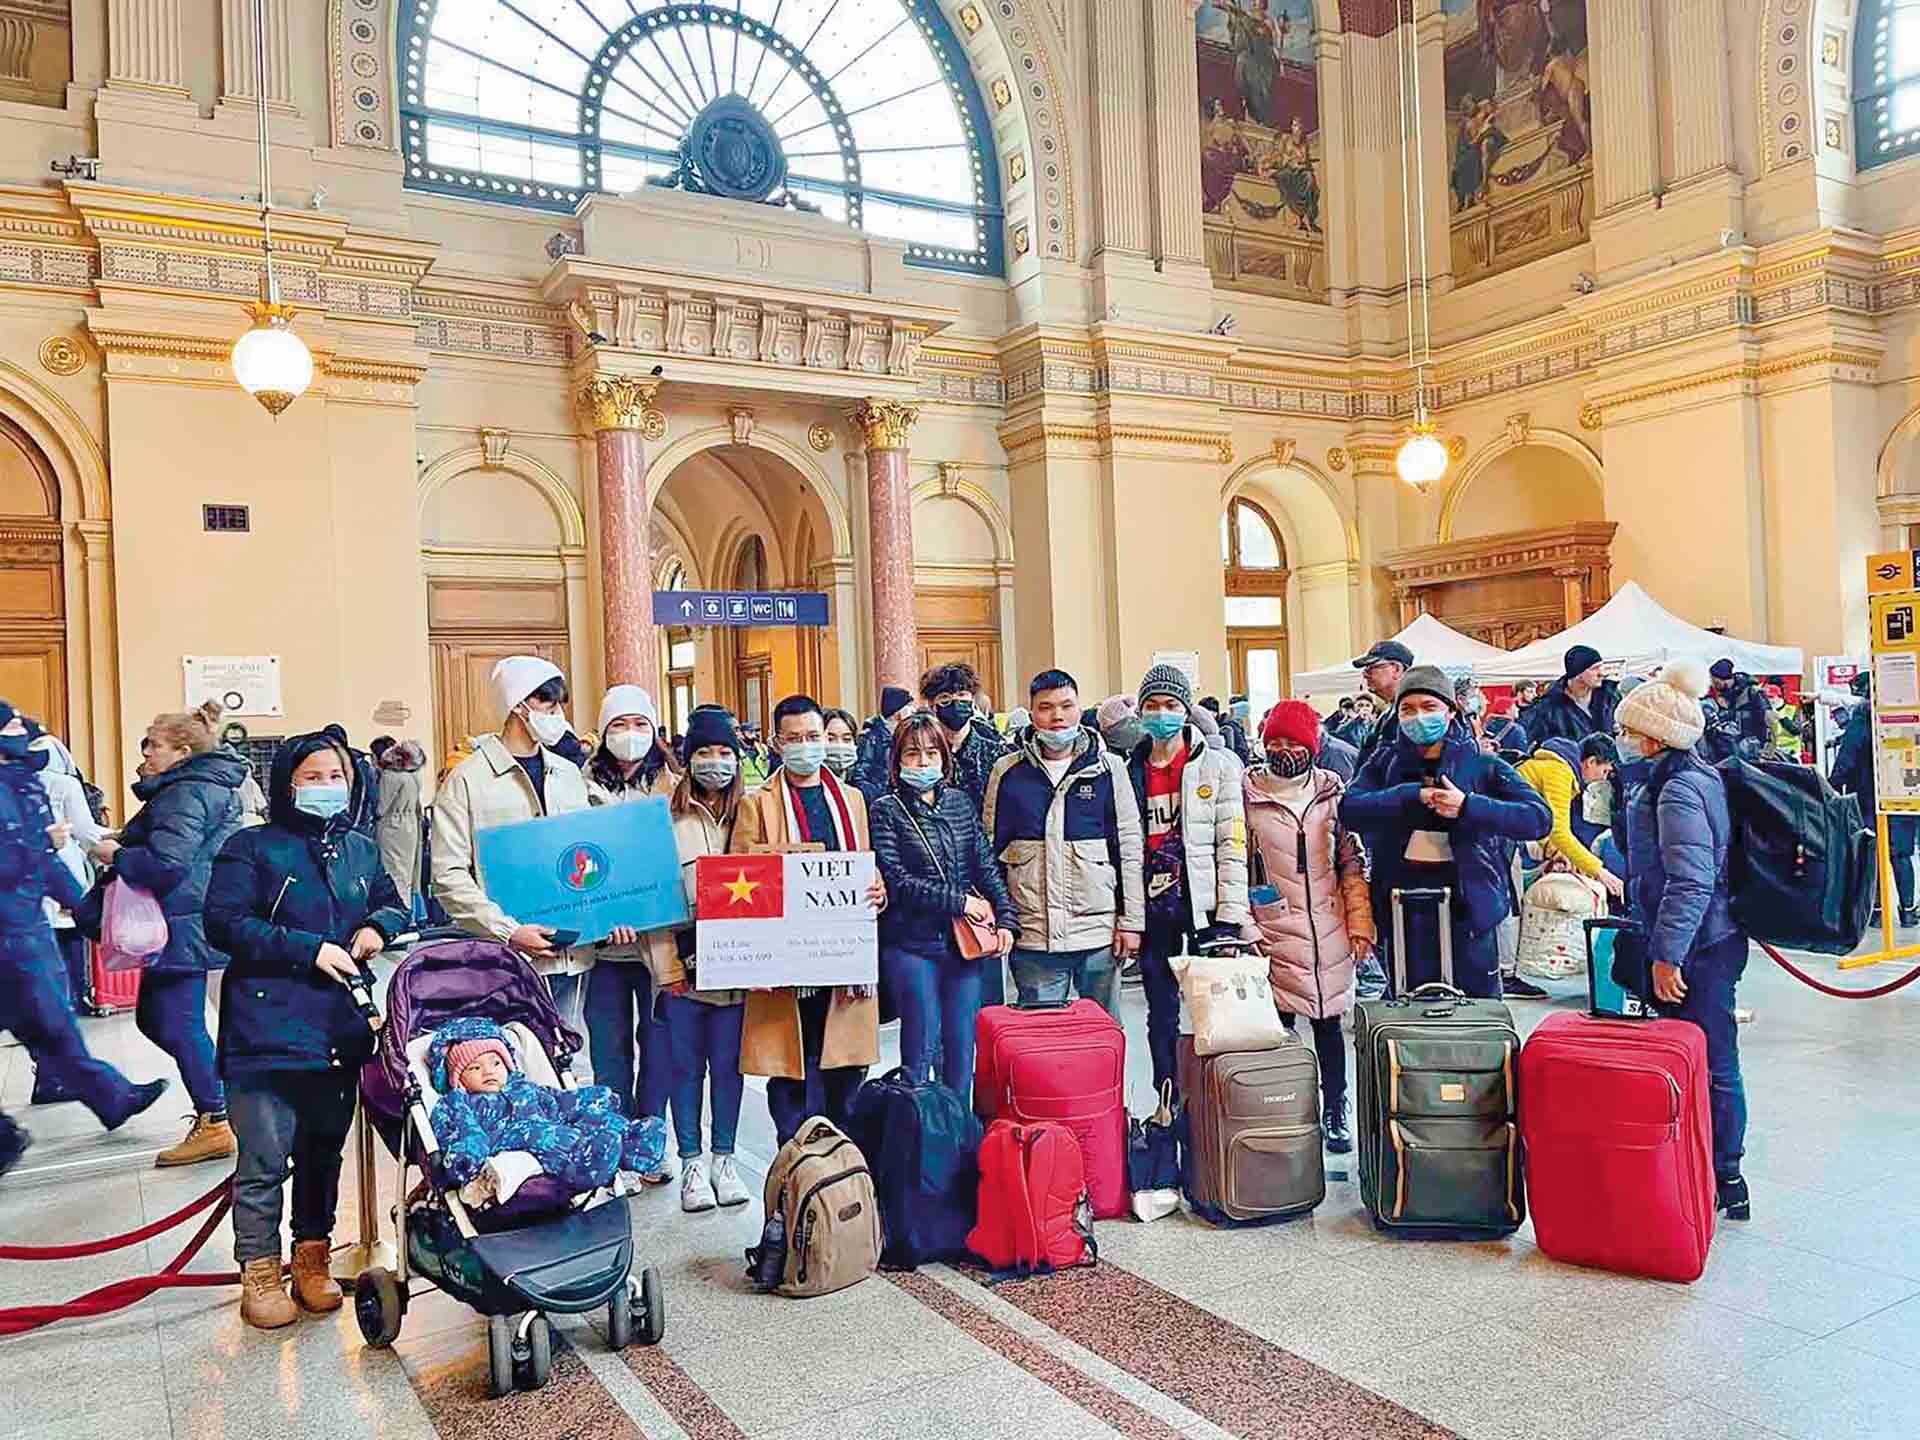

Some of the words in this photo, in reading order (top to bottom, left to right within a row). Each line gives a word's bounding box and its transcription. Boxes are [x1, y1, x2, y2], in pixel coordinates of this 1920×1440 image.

[752, 603, 771, 614] WC
[800, 858, 856, 881] VIỆT
[805, 889, 857, 907] NAM
